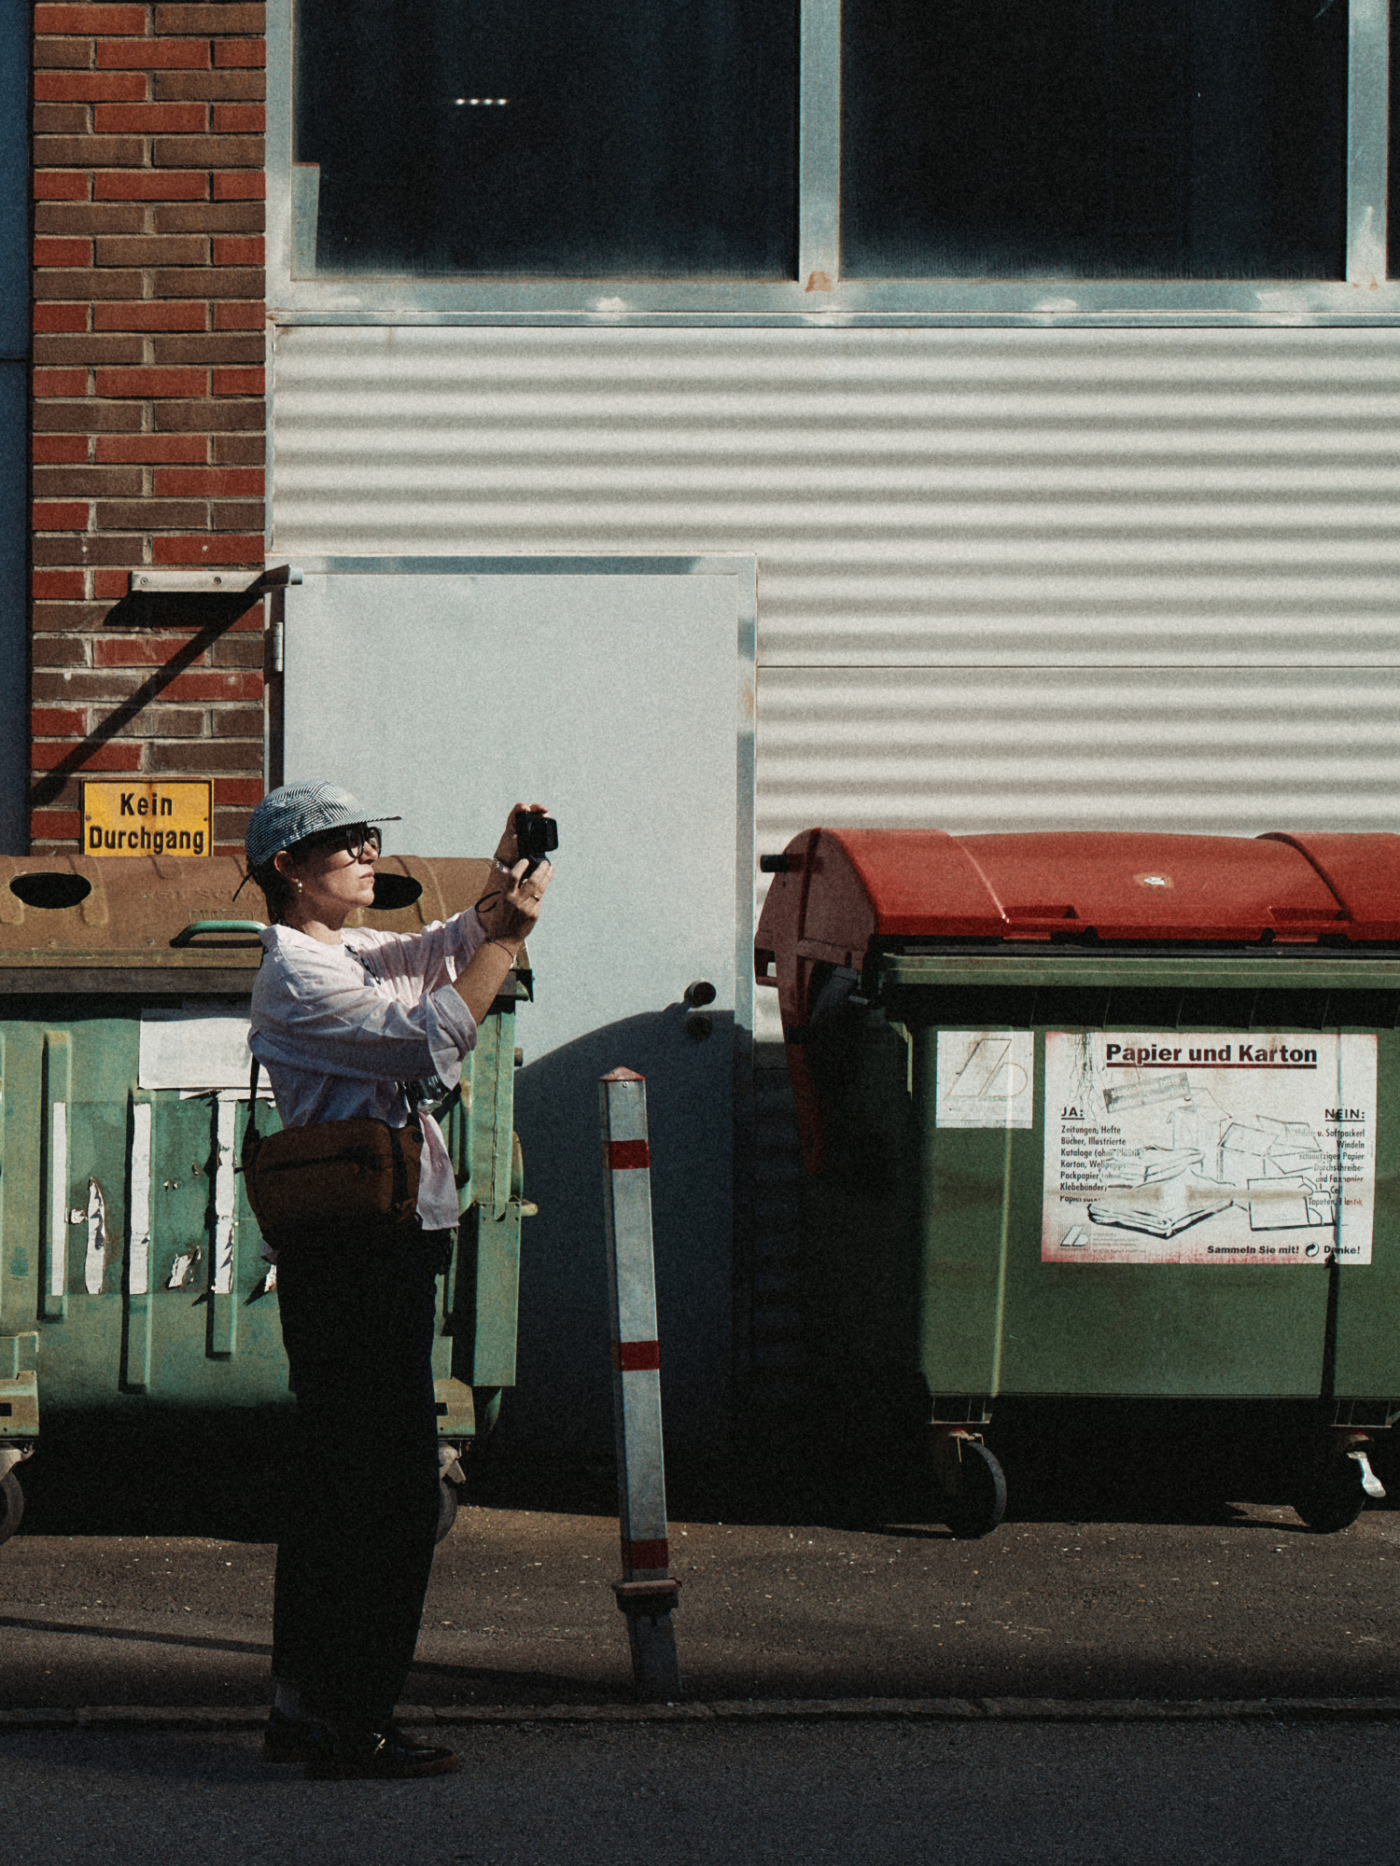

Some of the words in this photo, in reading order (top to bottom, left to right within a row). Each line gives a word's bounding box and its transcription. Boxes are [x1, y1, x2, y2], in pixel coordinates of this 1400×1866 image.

[120, 793, 173, 816] Kein
[89, 826, 204, 855] Durchgang
[1106, 1043, 1182, 1066] Papier
[1189, 1045, 1231, 1062] und
[1239, 1045, 1318, 1063] Karton
[1061, 1106, 1084, 1117] JA:
[1324, 1108, 1365, 1119] NEIN:
[1061, 1125, 1099, 1136] Zeitungen,
[1101, 1125, 1122, 1134] Hefte
[1061, 1136, 1087, 1146] Bücher,
[1089, 1136, 1127, 1146] Illustrierte
[1336, 1140, 1365, 1149] Windeln
[1061, 1148, 1093, 1159] Kataloge
[1343, 1152, 1365, 1162] Papier
[1061, 1160, 1087, 1169] Karton,
[1060, 1171, 1099, 1181] Packpapier
[1207, 1245, 1257, 1254] Sammeln
[1259, 1245, 1277, 1254] Sie
[1279, 1245, 1300, 1254] mit!
